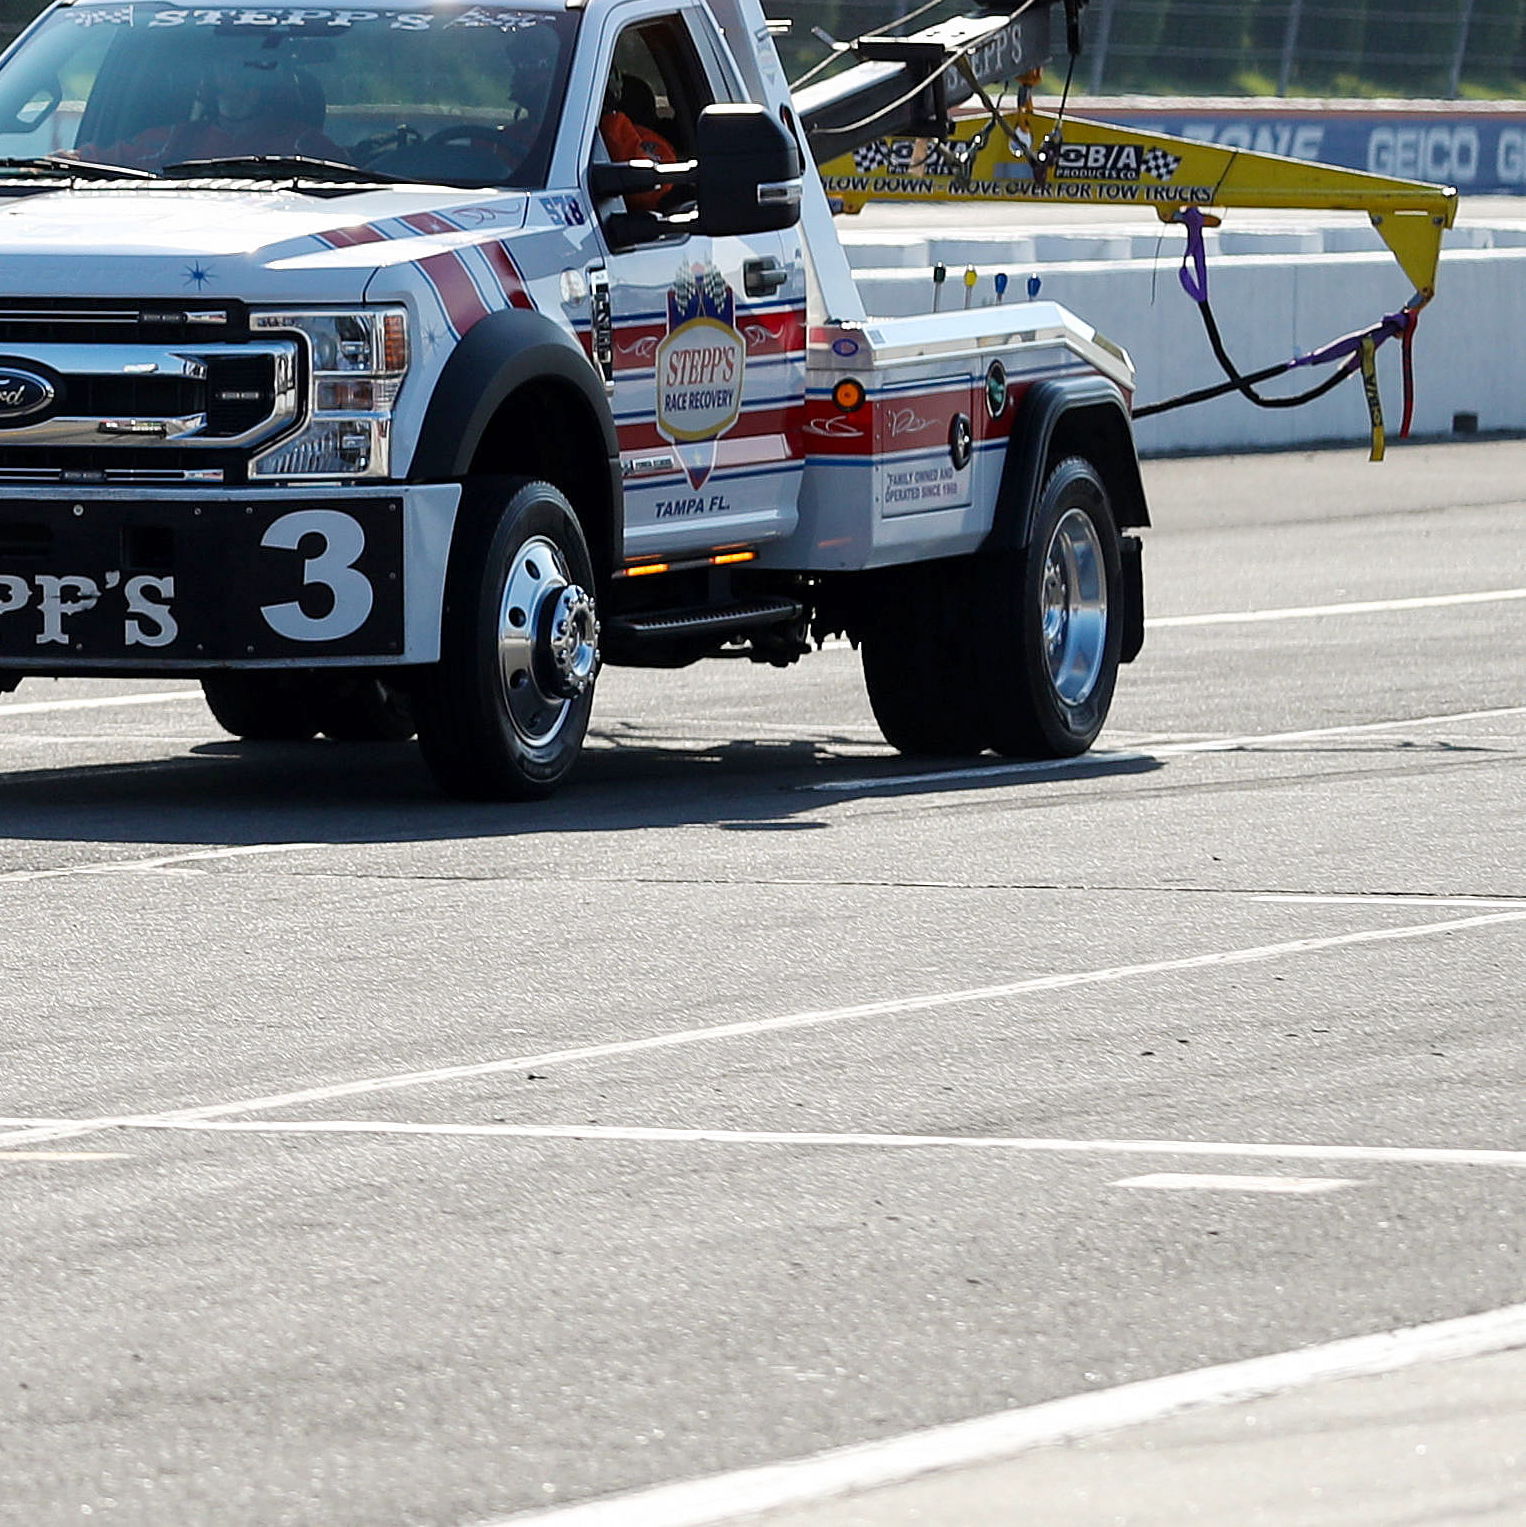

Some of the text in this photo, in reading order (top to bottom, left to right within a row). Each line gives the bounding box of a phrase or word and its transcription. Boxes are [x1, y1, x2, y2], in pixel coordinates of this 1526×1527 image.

[148, 7, 434, 30] STEPP'S
[947, 23, 1023, 90] SEPP'S
[1086, 145, 1137, 169] B/A
[1368, 126, 1479, 183] GEICO
[1056, 168, 1117, 178] PRODUCTS
[873, 176, 934, 193] DOWN
[948, 178, 1000, 196] MOVE
[1005, 180, 1052, 197] OVER
[1056, 182, 1092, 199] FOR
[1097, 184, 1140, 200] TOW
[1143, 184, 1212, 202] TRUCKS
[666, 345, 736, 388] STEPP'S
[664, 386, 733, 411] RACE RECOVERY
[655, 496, 731, 517] TAMPA FL.
[259, 509, 376, 642] 3
